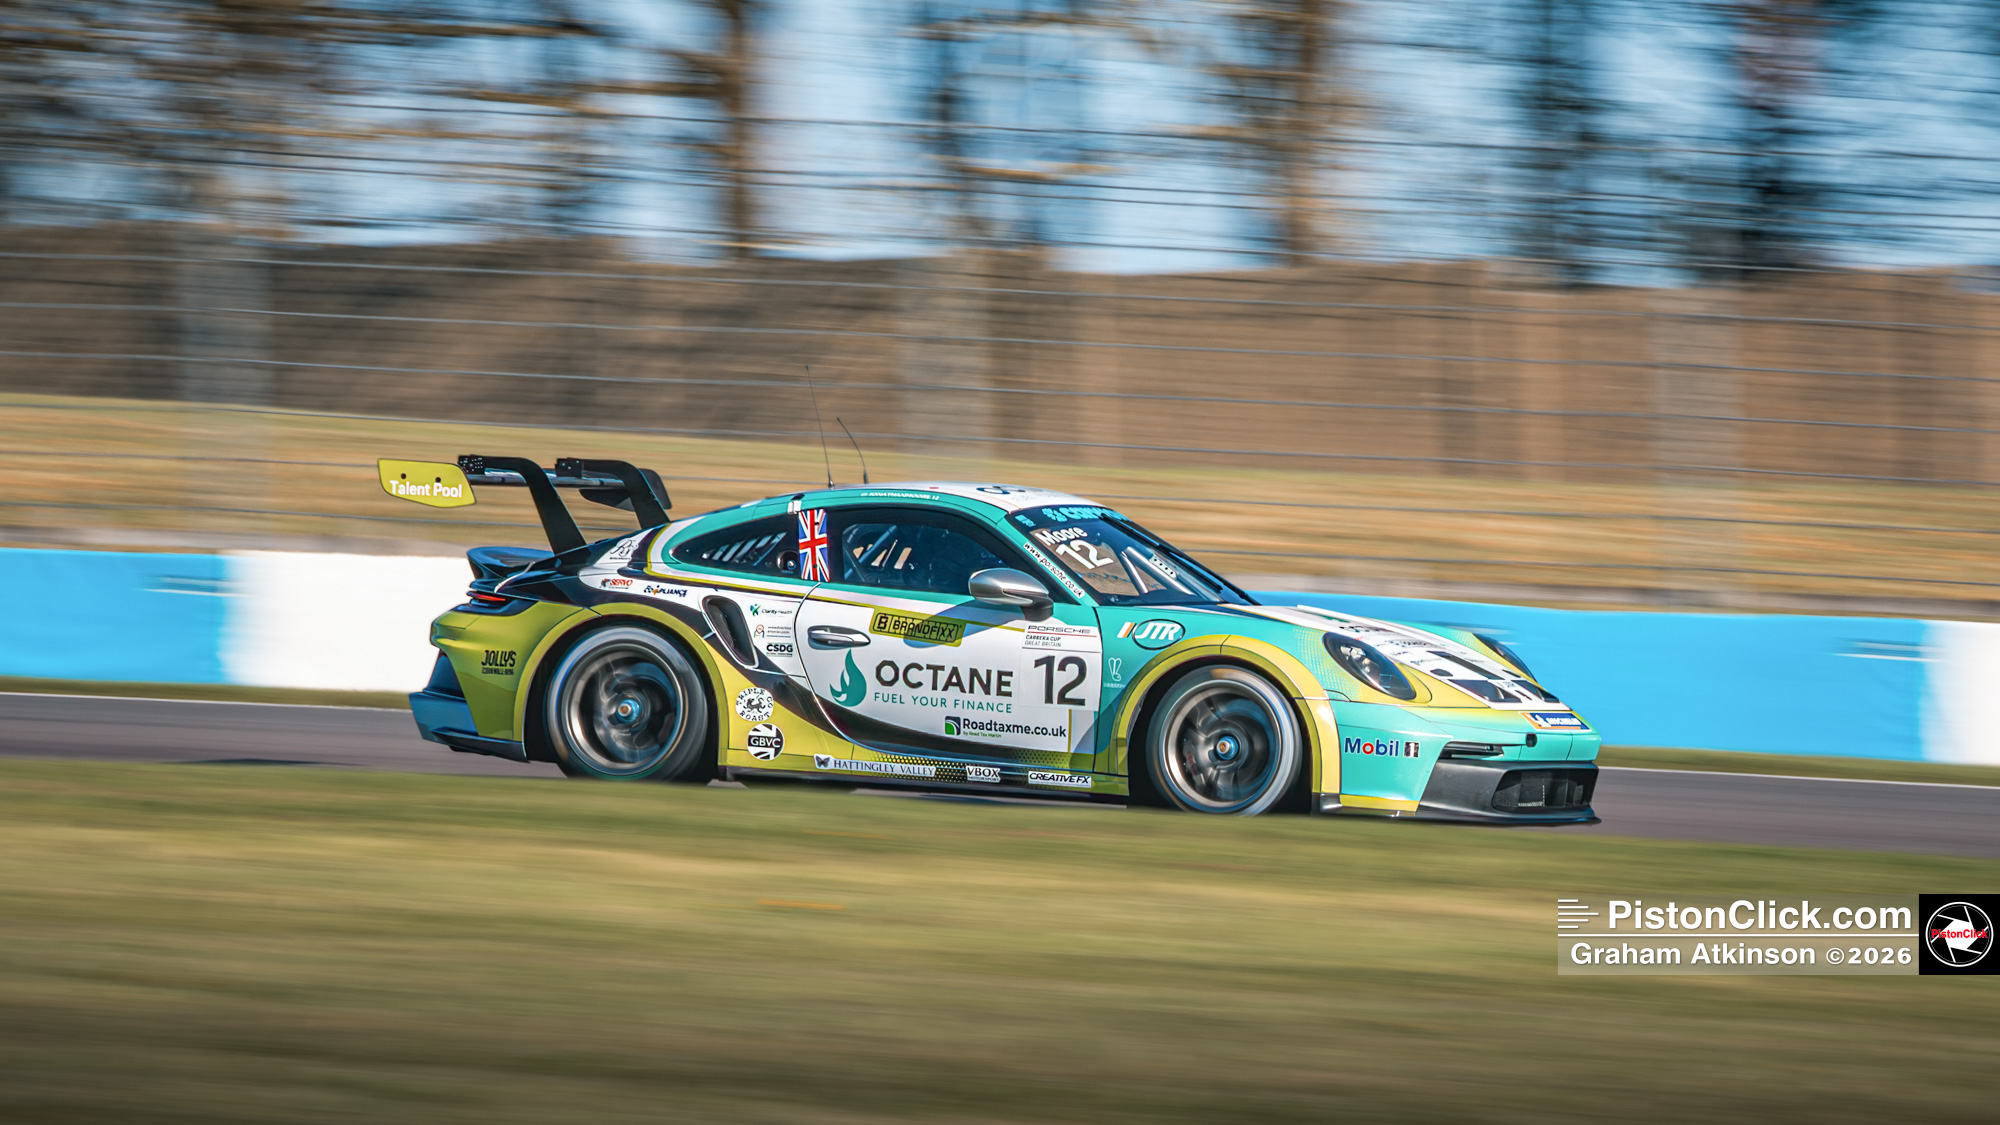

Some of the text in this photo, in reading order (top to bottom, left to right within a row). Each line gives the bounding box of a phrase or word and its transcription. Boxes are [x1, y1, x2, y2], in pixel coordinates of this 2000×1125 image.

[389, 480, 462, 498] Talent Pool
[1034, 527, 1088, 546] Moore
[1055, 539, 1114, 570] 12
[1024, 542, 1084, 597] www.porsche.co.uk
[892, 620, 955, 639] BRANDFIXX
[1027, 625, 1091, 634] PORSCHE
[1134, 622, 1181, 640] JTR
[766, 643, 794, 653] CSDG
[875, 659, 1014, 698] OCTANE
[1033, 655, 1087, 707] 12
[874, 692, 1013, 714] FUEL YOUR FINANCE
[962, 718, 1067, 738] Roadtaxme.co.uk
[750, 736, 781, 748] GBVC
[1344, 737, 1399, 757] Mobil
[833, 759, 935, 776] HATTINGLEY VALLEY
[967, 767, 999, 778] VBOX
